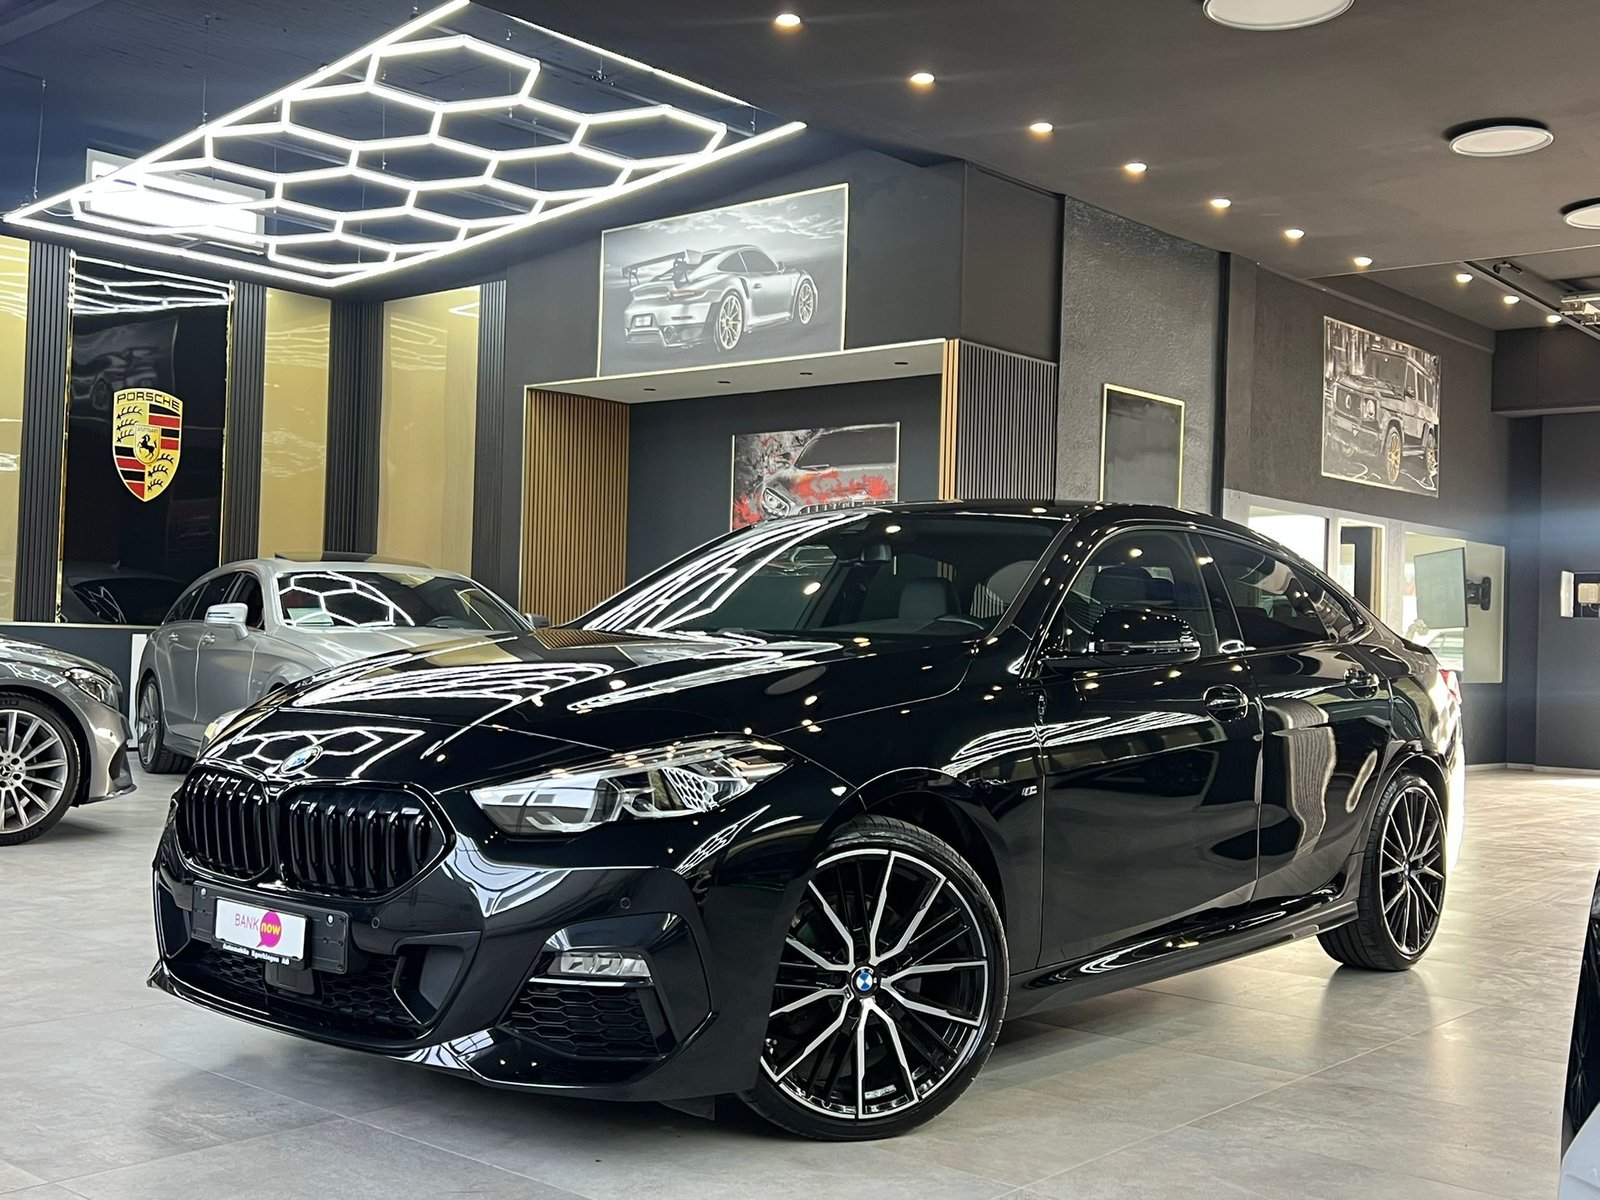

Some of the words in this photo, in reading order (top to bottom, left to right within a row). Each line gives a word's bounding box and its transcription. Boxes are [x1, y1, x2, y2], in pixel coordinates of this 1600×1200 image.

[117, 392, 179, 411] PORSCHE
[235, 913, 259, 930] BANK
[261, 923, 281, 935] now
